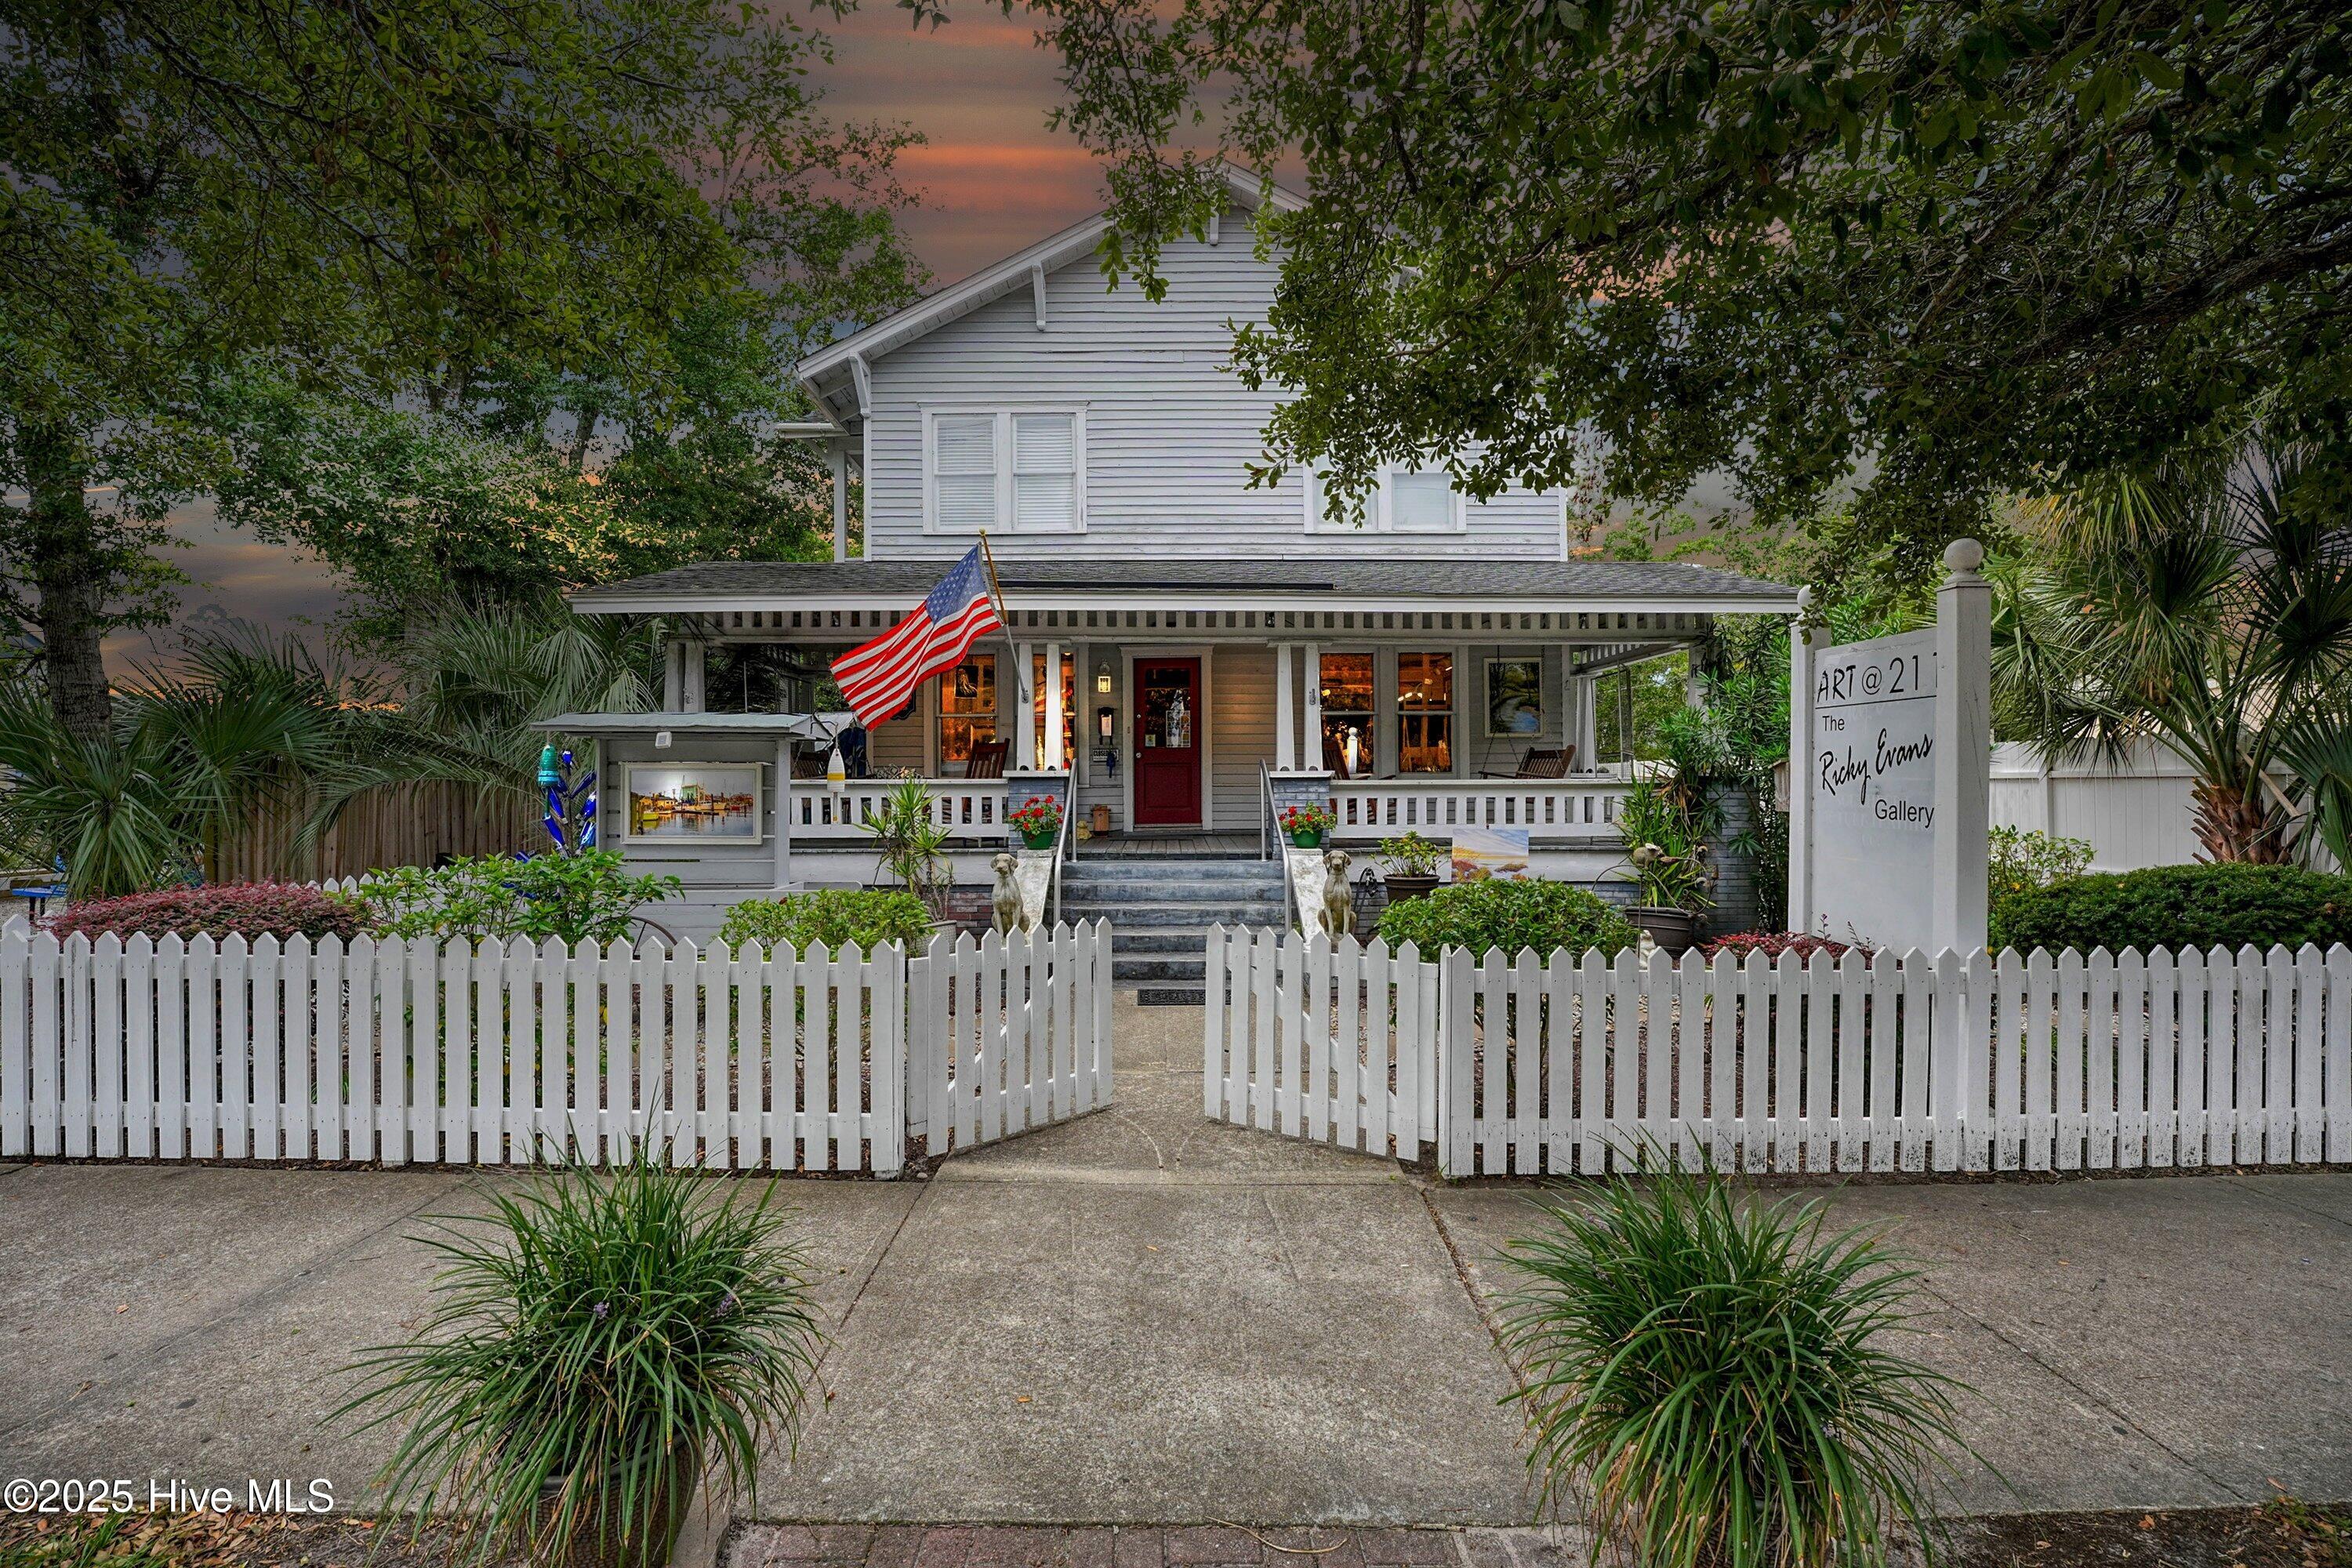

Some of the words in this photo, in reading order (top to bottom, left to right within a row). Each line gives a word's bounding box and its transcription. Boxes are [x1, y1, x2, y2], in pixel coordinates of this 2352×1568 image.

[1817, 665, 1857, 702] ART
[1863, 666, 1882, 695] @
[1822, 715, 1846, 731] The
[1819, 746, 1871, 806] Ricky
[1875, 728, 1933, 775] Evans
[1875, 799, 1935, 829] Gallery
